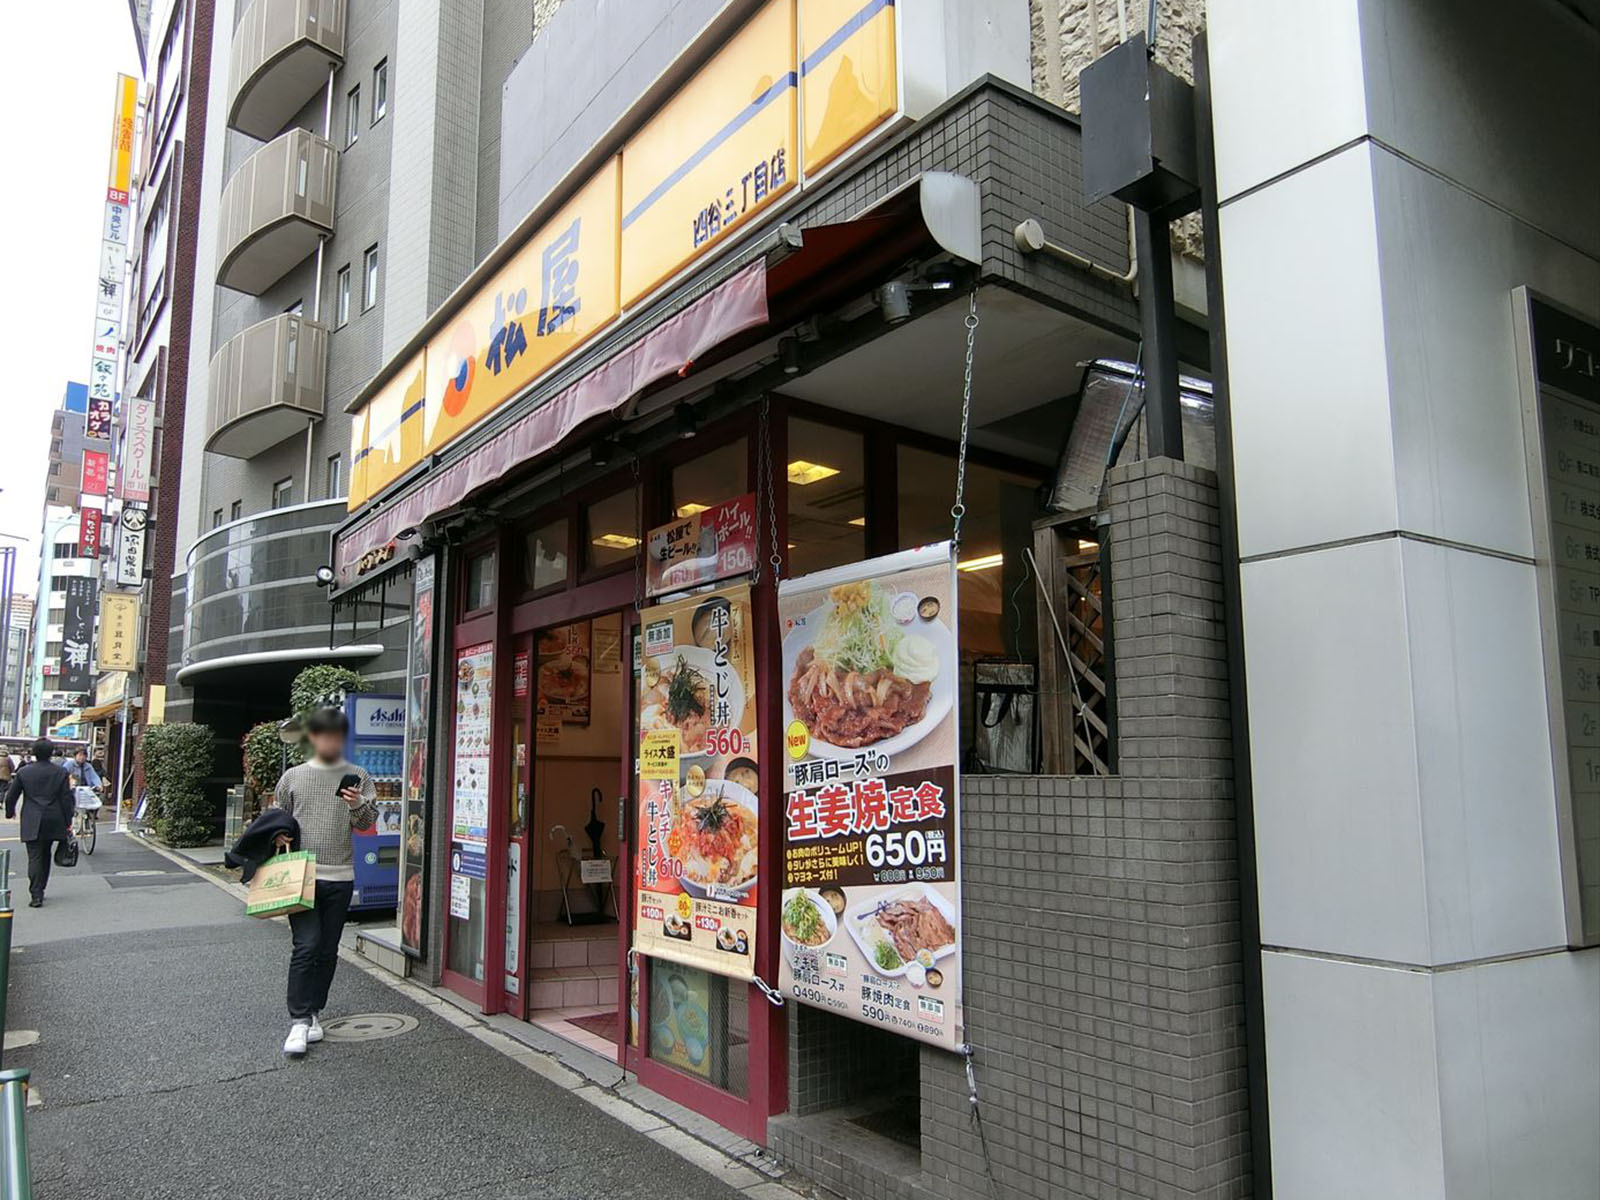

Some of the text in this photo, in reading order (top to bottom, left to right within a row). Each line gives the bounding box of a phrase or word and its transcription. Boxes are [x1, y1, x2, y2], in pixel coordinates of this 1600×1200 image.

[109, 190, 127, 204] 8F
[692, 147, 786, 248] 四谷三丁目店
[485, 217, 581, 377] 松屋
[89, 401, 110, 430] カラオケ
[131, 403, 149, 479] ダンススクール
[718, 502, 740, 523] ハイ
[711, 607, 730, 725] 牛とじ丼
[643, 745, 676, 760] ライス大盛
[706, 727, 751, 756] 560円
[787, 732, 806, 747] New
[659, 780, 671, 841] キムチ
[787, 780, 945, 839] 生姜焼定食
[647, 801, 659, 885] 牛とじ丼
[866, 830, 947, 867] 650円
[861, 985, 911, 1011] 豚焼肉定食
